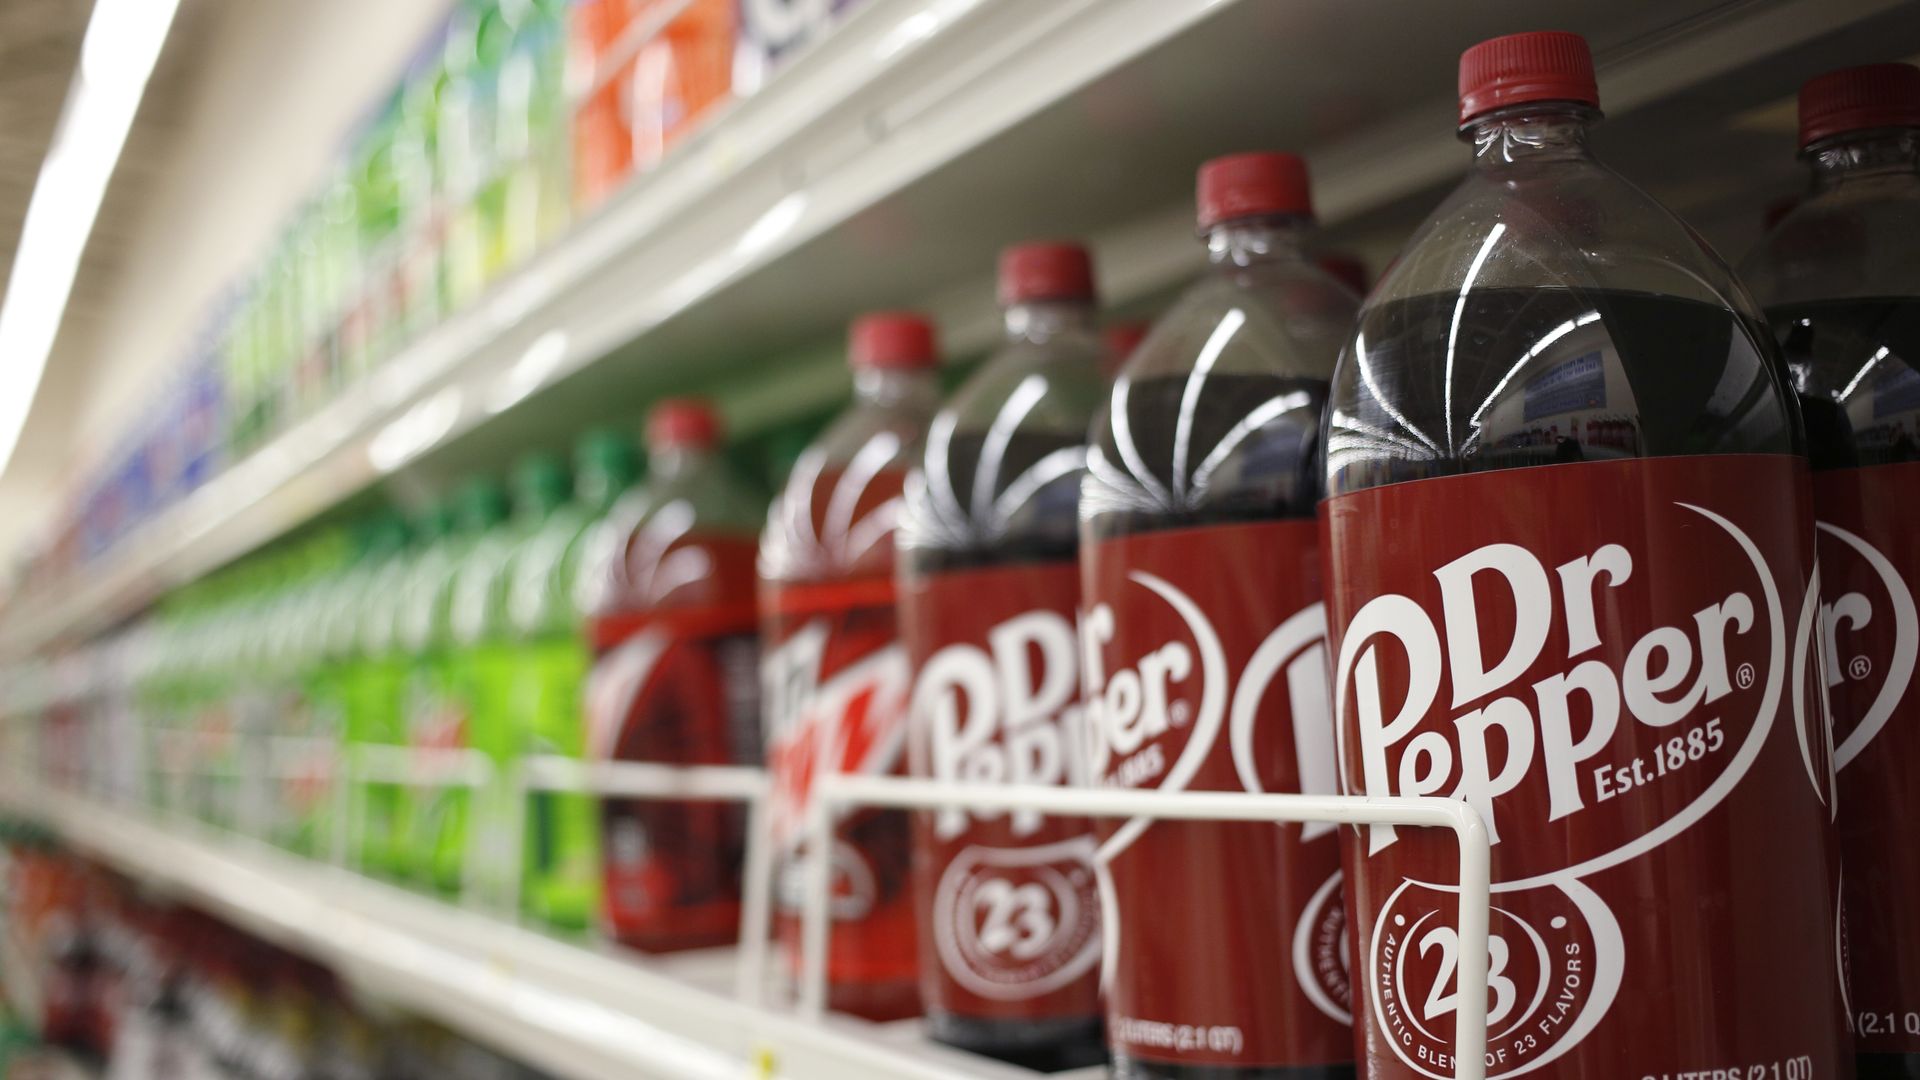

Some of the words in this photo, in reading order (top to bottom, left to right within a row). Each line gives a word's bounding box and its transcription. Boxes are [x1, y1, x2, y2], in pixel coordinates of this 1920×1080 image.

[988, 609, 1080, 729] D
[1433, 543, 1633, 710] Dr
[1336, 592, 1755, 857] Pepper
[1593, 717, 1725, 803] Est.1885
[973, 880, 1055, 959] 23
[1382, 932, 1413, 1046] AUTHENTIC
[1417, 1044, 1457, 1070] BLEN
[1485, 1048, 1507, 1068] OF
[1514, 1034, 1537, 1056] 23
[1538, 942, 1582, 1036] FLAVORS
[1419, 926, 1517, 1027] 23
[1858, 1010, 1896, 1038] (2.1
